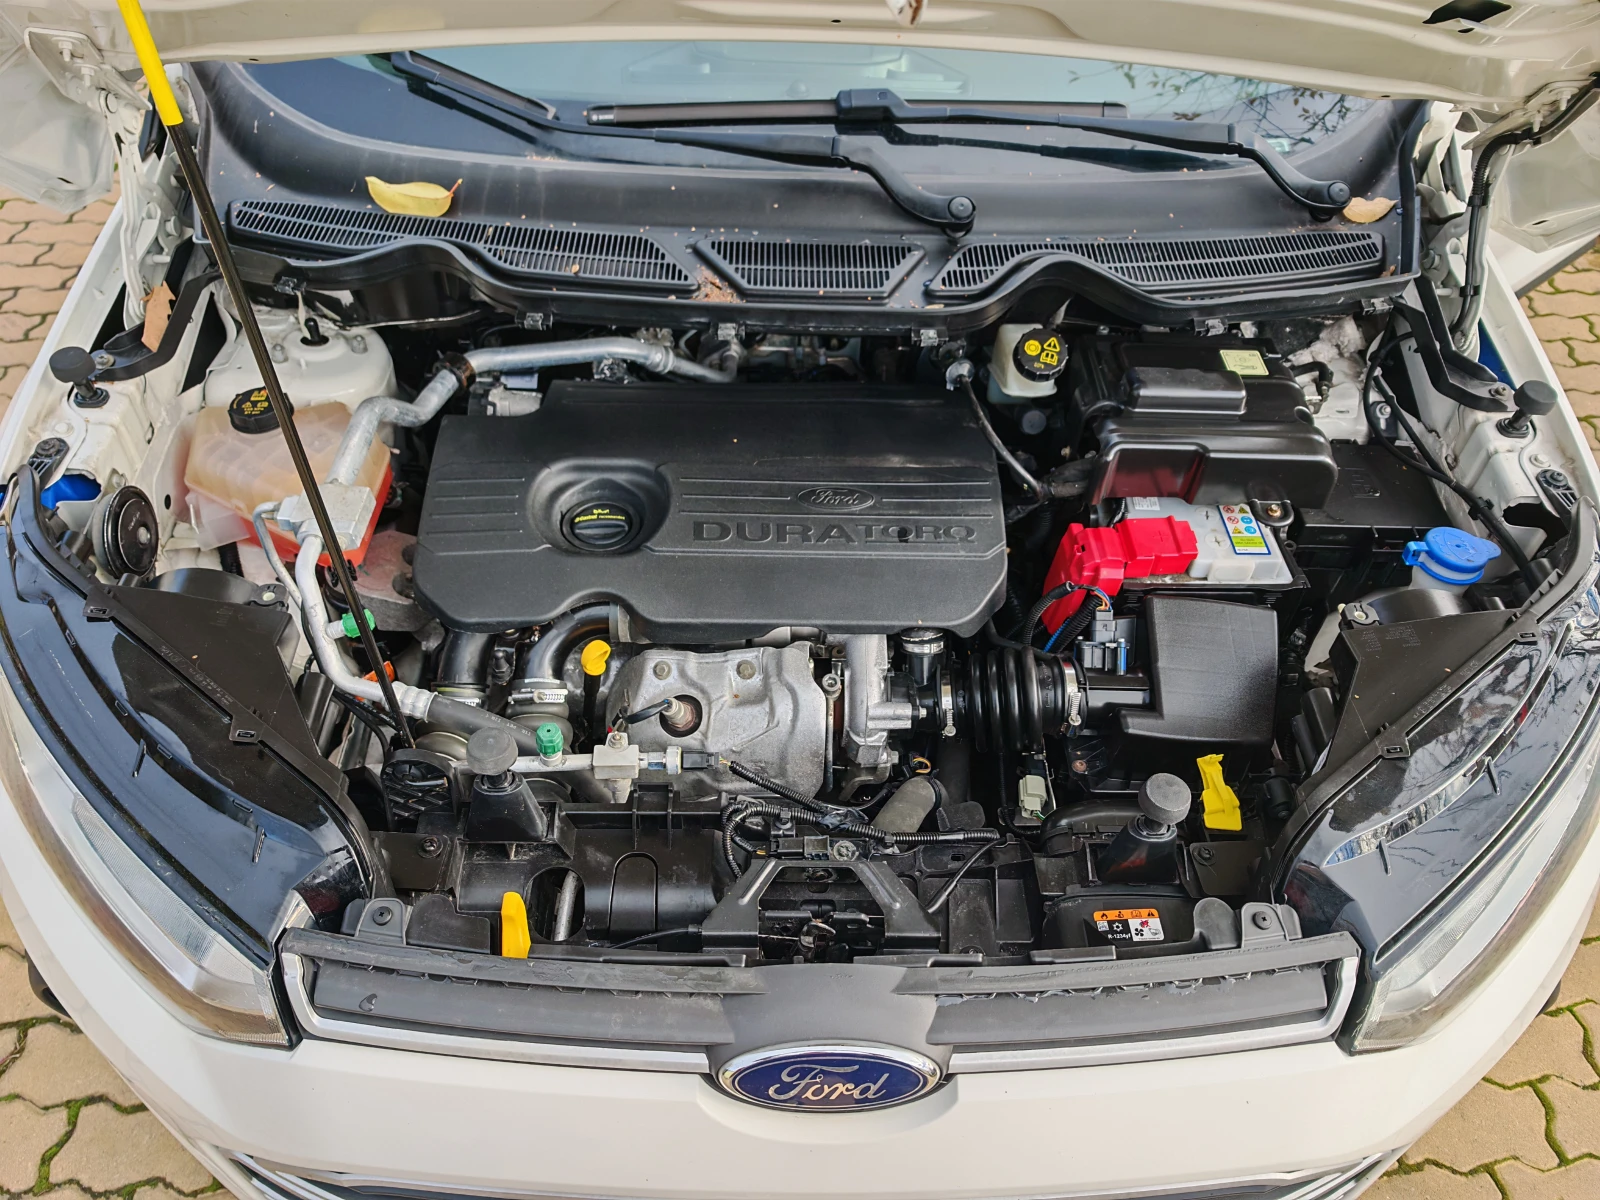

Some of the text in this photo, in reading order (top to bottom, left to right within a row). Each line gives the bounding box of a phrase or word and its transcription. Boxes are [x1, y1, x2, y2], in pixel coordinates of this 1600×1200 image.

[810, 489, 860, 505] Ford
[692, 520, 978, 544] DURATORQ
[768, 1064, 890, 1101] Ford
